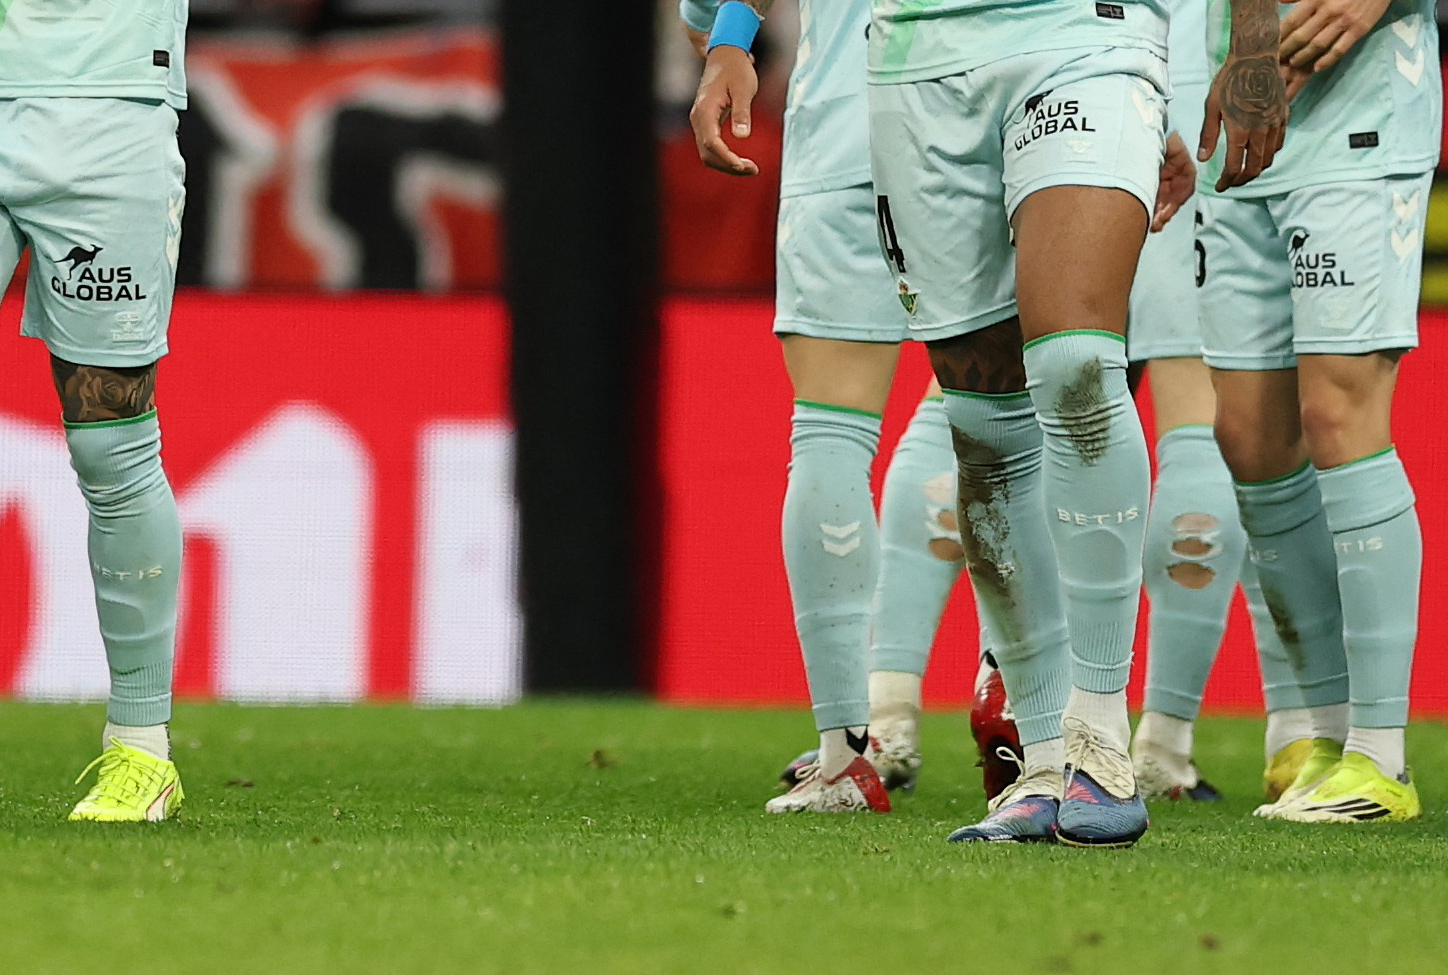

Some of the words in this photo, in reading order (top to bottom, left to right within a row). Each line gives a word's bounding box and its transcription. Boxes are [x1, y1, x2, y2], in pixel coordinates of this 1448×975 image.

[1033, 100, 1079, 126] AUS
[1015, 117, 1096, 151] GLOBAL
[1294, 253, 1337, 270] AUS
[78, 266, 132, 284] AUS
[51, 276, 147, 302] GLOBAL
[1056, 507, 1139, 527] BETIS
